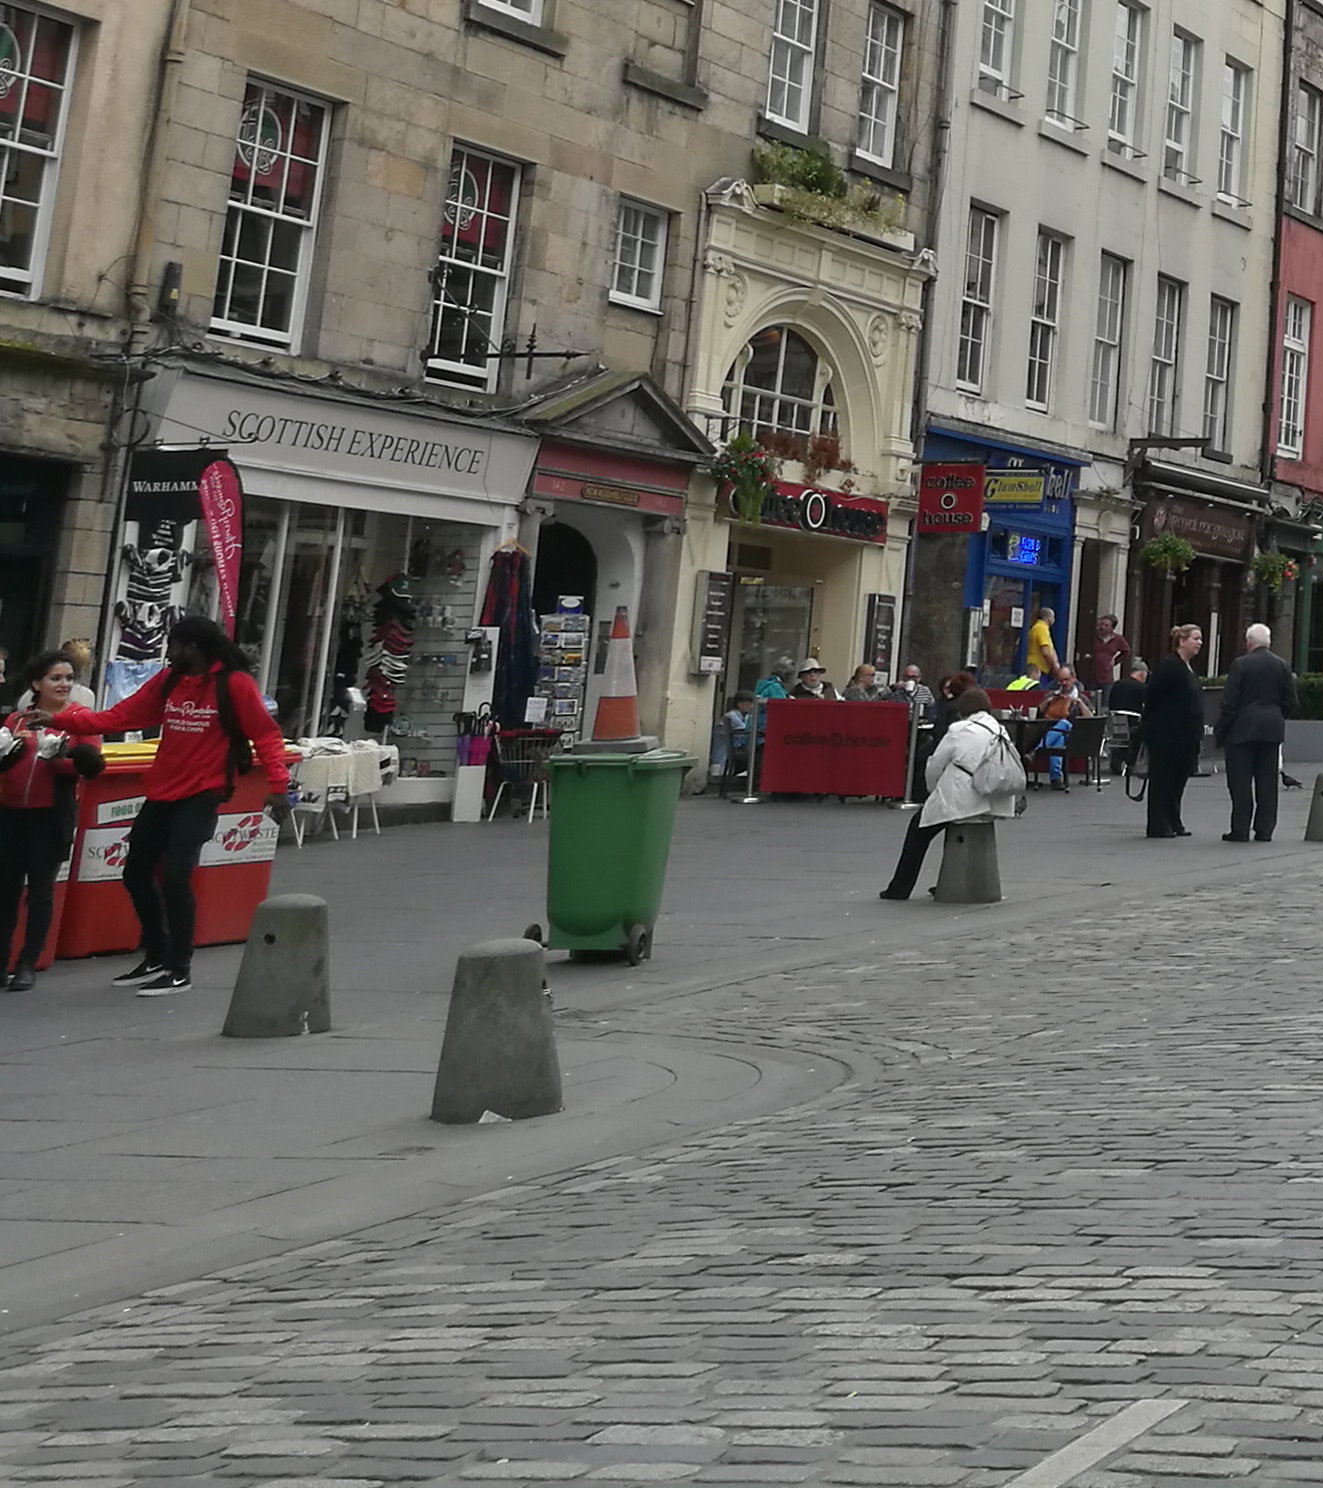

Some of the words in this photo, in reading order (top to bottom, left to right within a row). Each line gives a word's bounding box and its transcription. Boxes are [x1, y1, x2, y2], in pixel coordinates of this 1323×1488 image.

[223, 410, 346, 453] SCOTTISH
[346, 429, 484, 475] EXPERIENCE
[133, 480, 198, 493] WARHAMM
[925, 474, 976, 488] coffee
[922, 509, 974, 525] house
